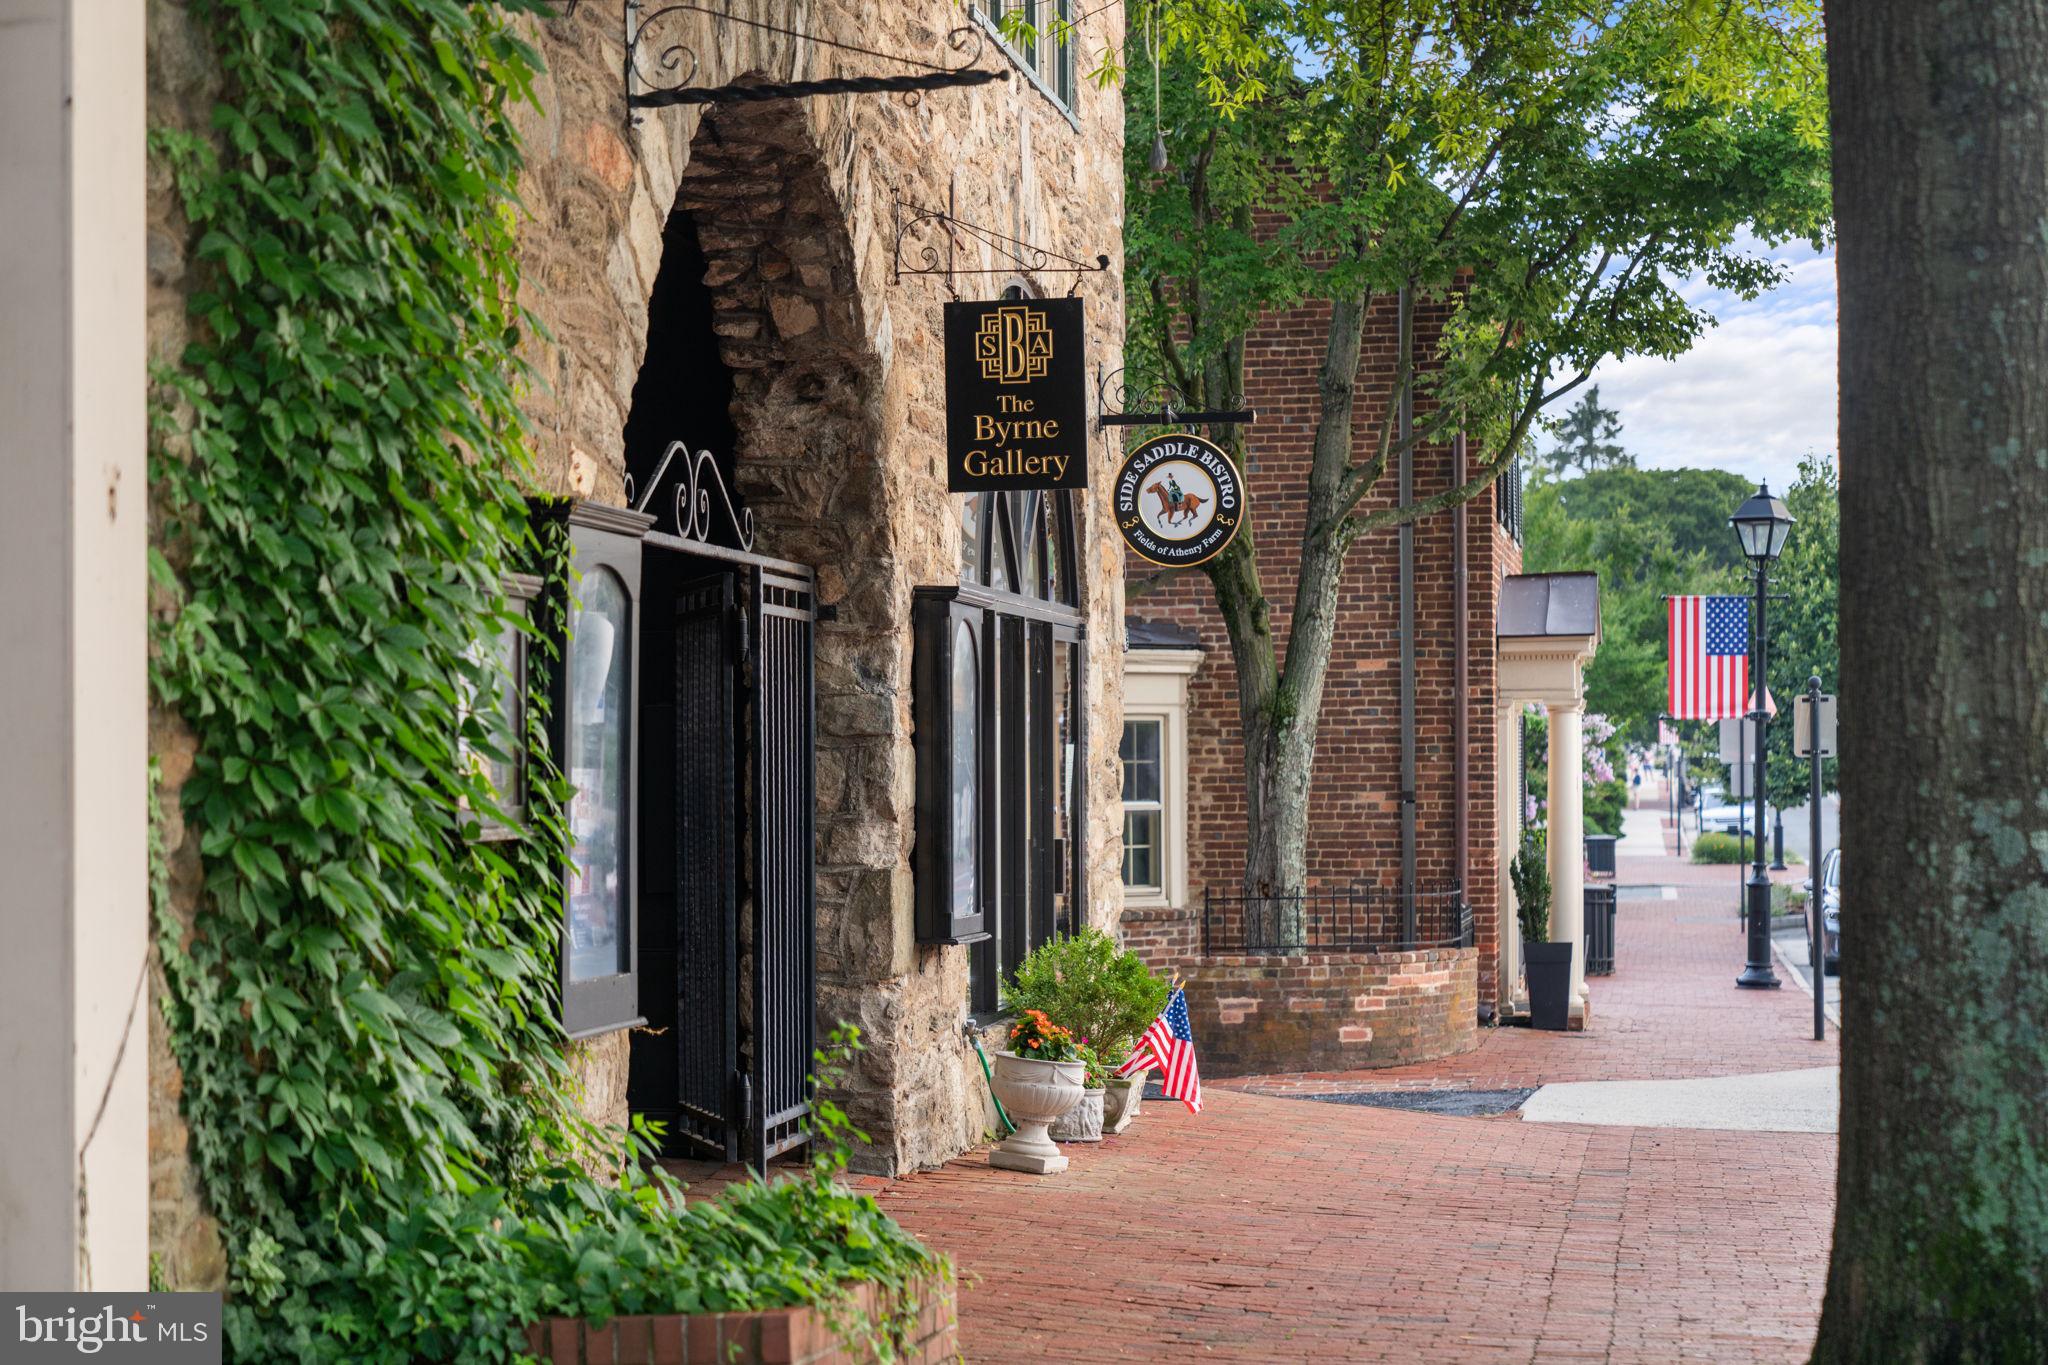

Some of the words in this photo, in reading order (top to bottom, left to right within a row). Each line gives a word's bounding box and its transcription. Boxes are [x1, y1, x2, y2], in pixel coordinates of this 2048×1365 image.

[997, 395, 1035, 413] The
[974, 415, 1059, 447] Byrne
[963, 449, 1071, 481] Gallery
[1120, 472, 1138, 511] SIDE
[1134, 442, 1200, 473] SADDLE
[1199, 450, 1235, 509] BISTRO
[1133, 530, 1156, 551] Fields
[1157, 547, 1168, 555] of
[1168, 545, 1202, 557] Athenry
[1203, 529, 1223, 548] Farm
